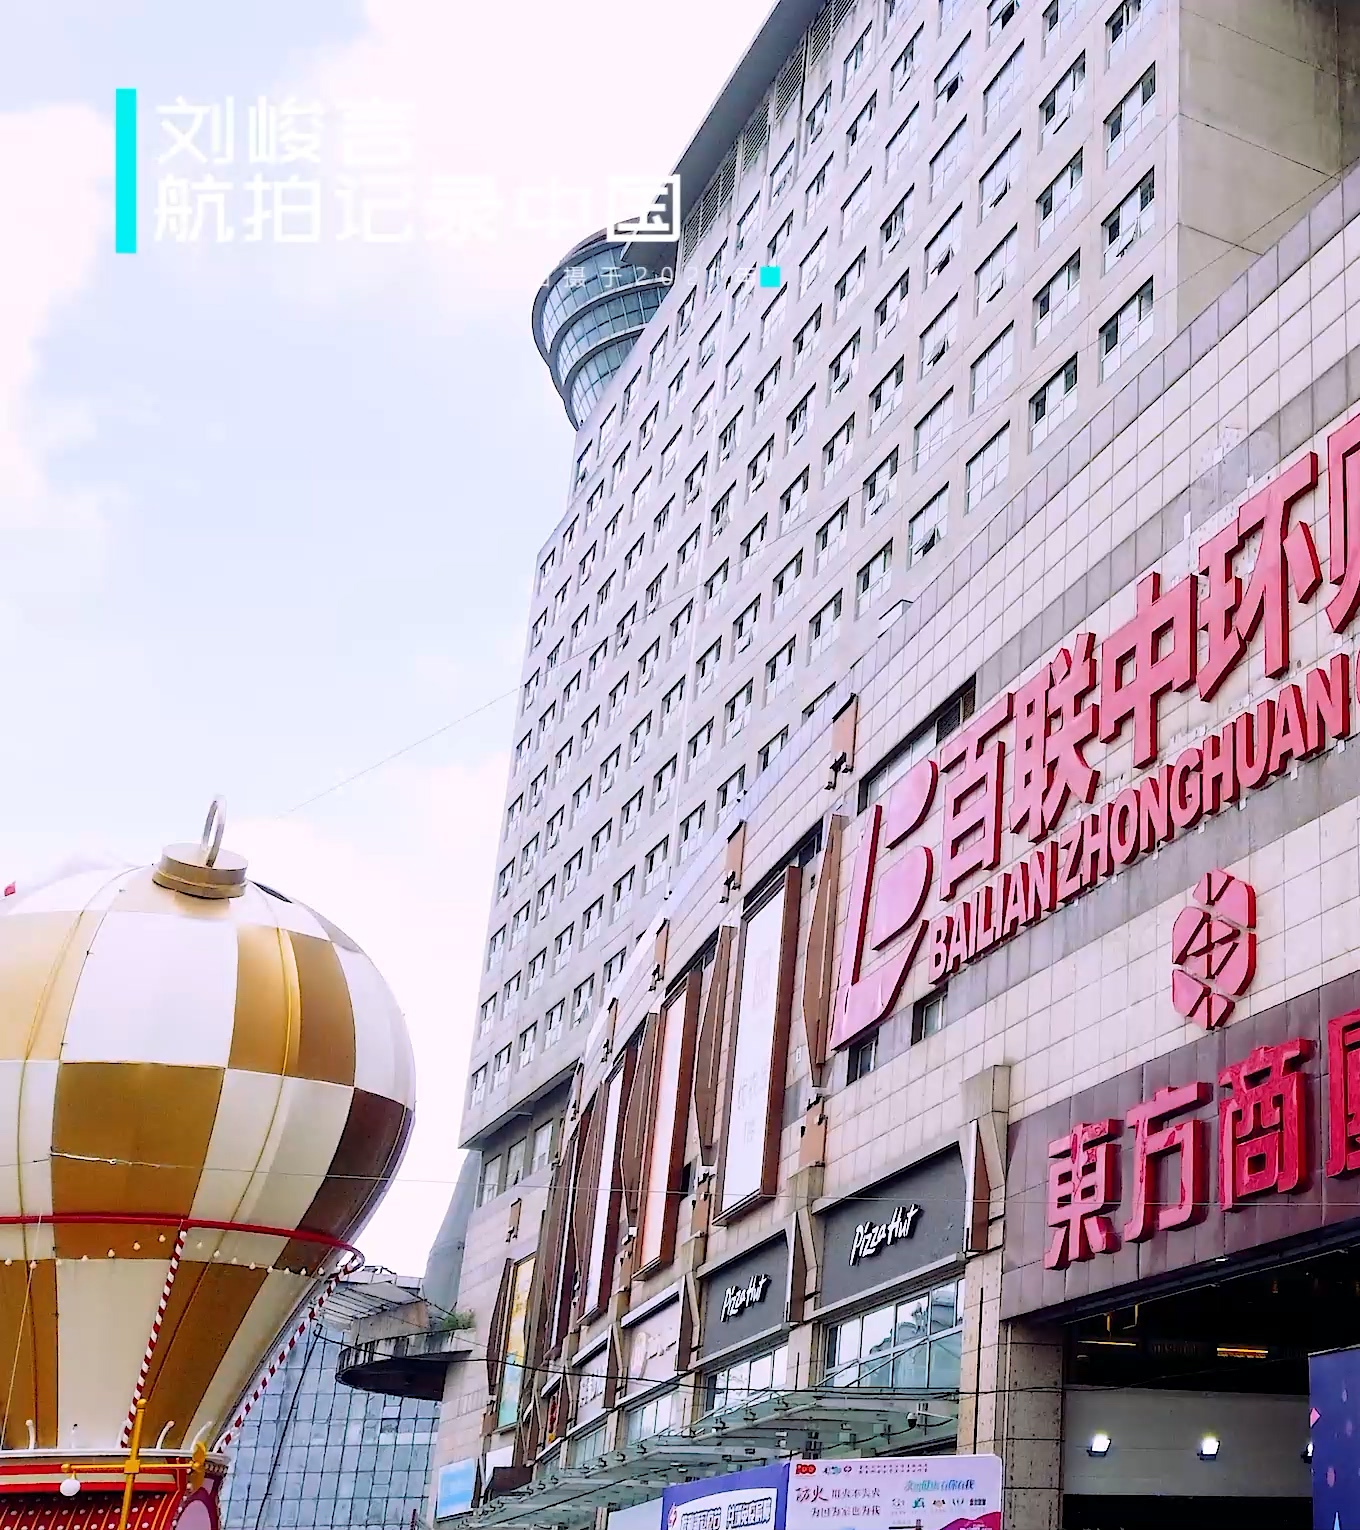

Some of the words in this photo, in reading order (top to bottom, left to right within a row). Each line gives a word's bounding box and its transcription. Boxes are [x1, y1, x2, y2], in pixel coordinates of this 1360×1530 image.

[928, 840, 1058, 985] BAILIAN
[1056, 653, 1352, 904] ZHONGHUAN
[849, 1221, 889, 1266] Pizza
[886, 1203, 921, 1246] Hut
[720, 1286, 748, 1323] Pizza
[745, 1273, 769, 1303] Hut
